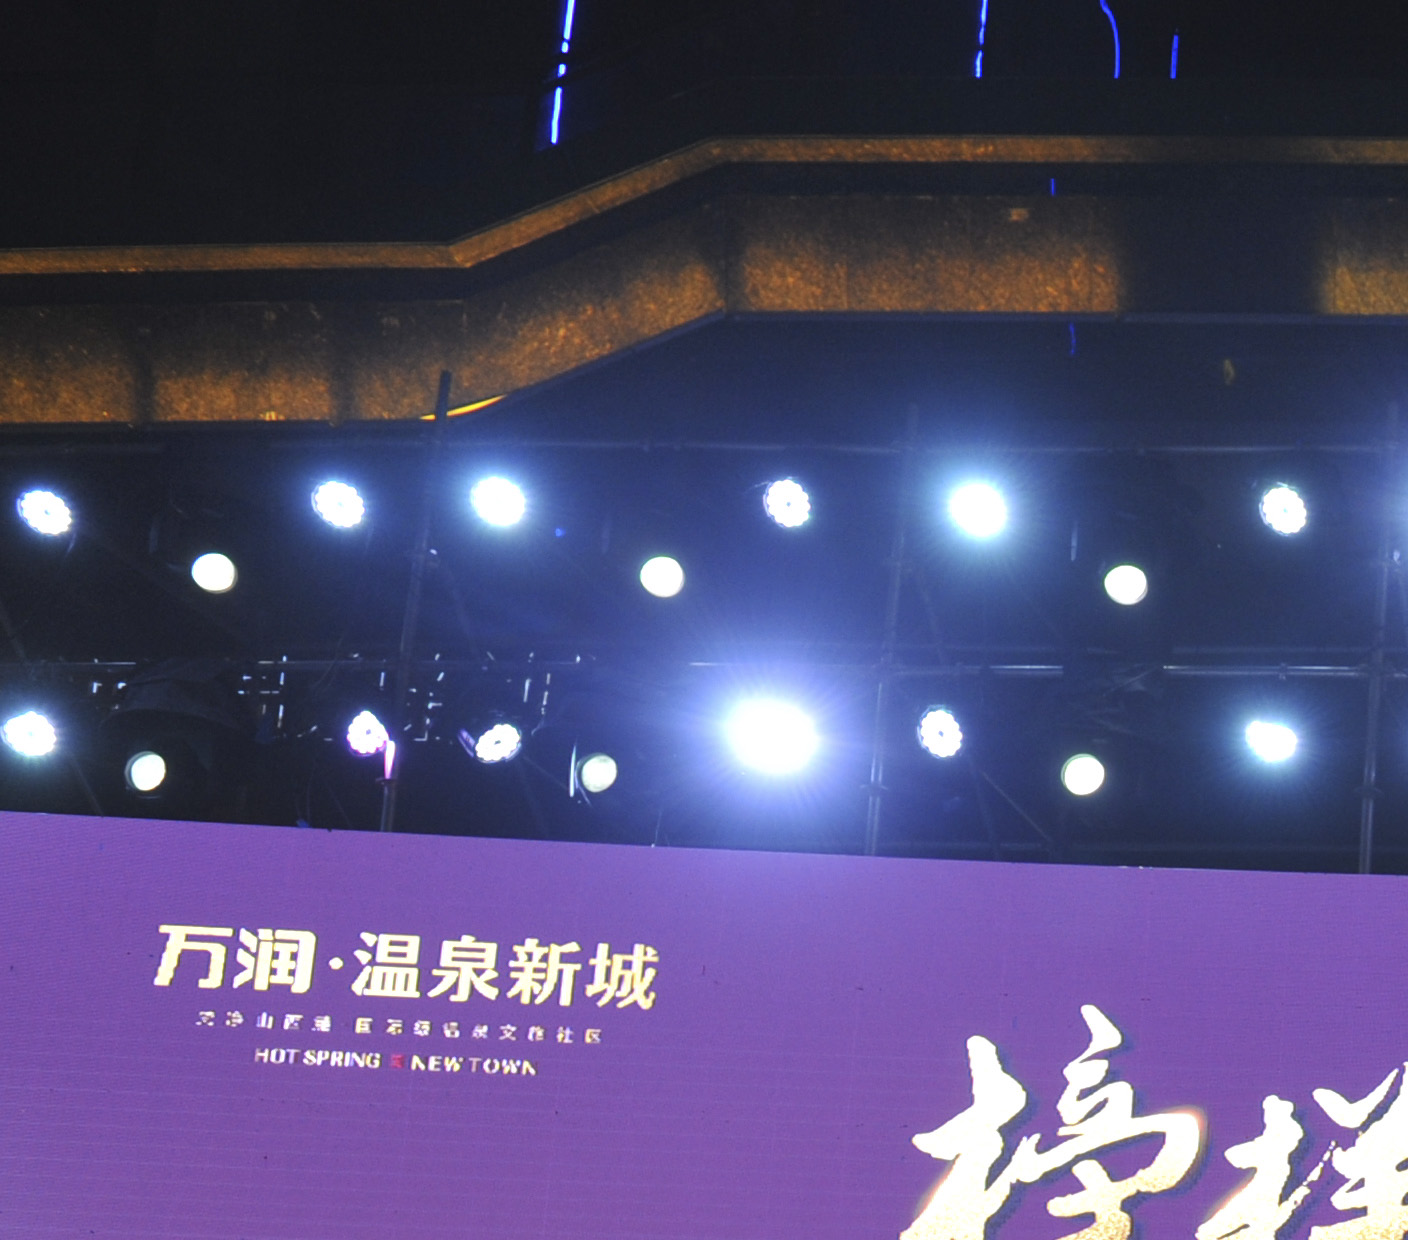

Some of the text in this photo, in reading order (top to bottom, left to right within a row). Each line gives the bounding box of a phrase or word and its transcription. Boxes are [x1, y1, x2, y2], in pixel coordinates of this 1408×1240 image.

[153, 924, 659, 1010] 万润·温泉新城
[254, 1047, 538, 1076] HOT SPRING NEW TOWN
